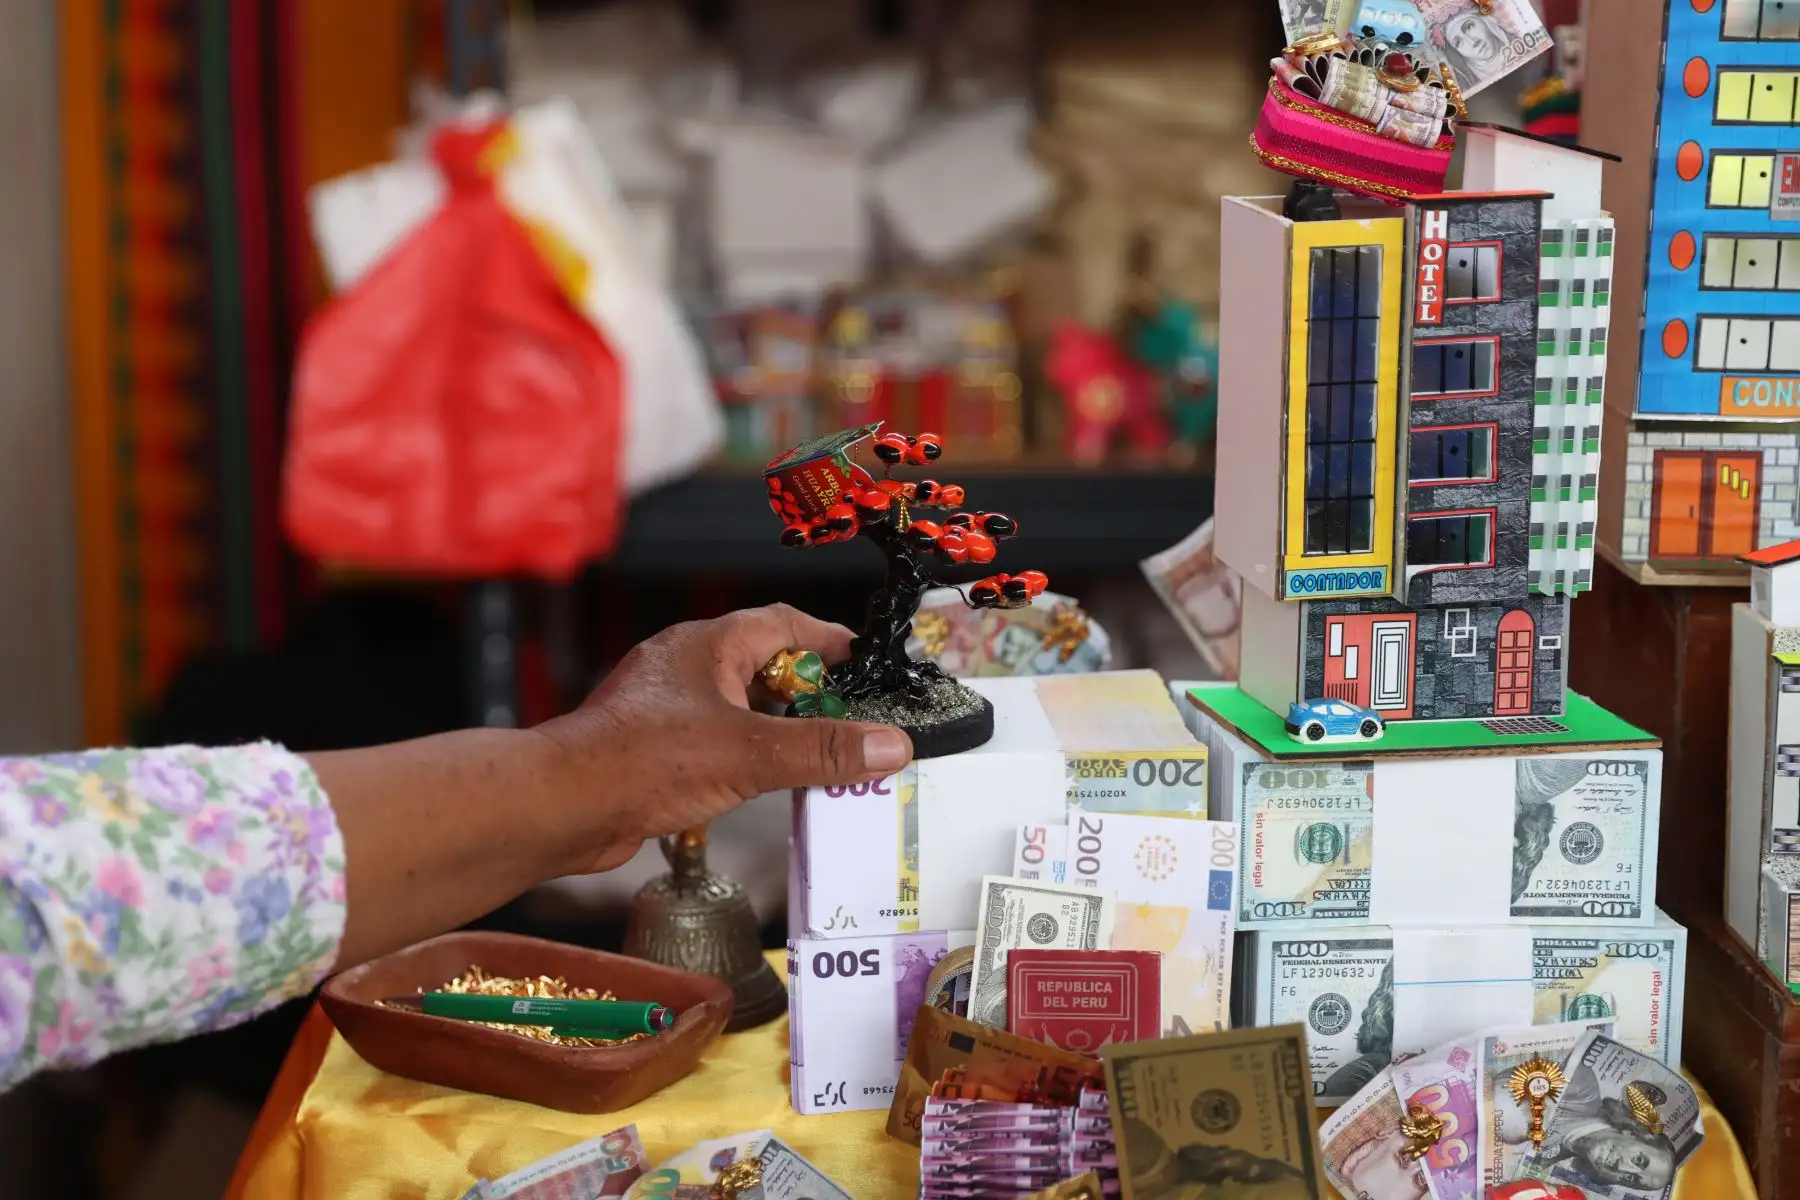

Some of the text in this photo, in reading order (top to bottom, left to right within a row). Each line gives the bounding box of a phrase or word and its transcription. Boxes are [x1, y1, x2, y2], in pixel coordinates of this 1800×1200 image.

[1420, 210, 1448, 321] HOTEL
[1290, 571, 1382, 593] CONTADOR
[1133, 759, 1206, 787] 200
[1586, 761, 1638, 776] 100
[1258, 770, 1330, 789] 100
[1021, 826, 1047, 865] 50
[1075, 816, 1103, 875] 200
[1209, 826, 1236, 868] 200
[1252, 812, 1265, 888] sin valor legal
[1254, 901, 1306, 918] 100
[1582, 901, 1636, 916] 100
[1278, 942, 1329, 958] 100
[1604, 943, 1660, 958] 100
[812, 949, 880, 979] 500
[1283, 968, 1298, 979] LF
[1302, 967, 1364, 978] 12304632
[1037, 981, 1113, 994] REPUBLICA
[1281, 986, 1297, 997] F6
[1043, 997, 1108, 1009] DEL PERU
[1650, 971, 1663, 1045] sin valor legal
